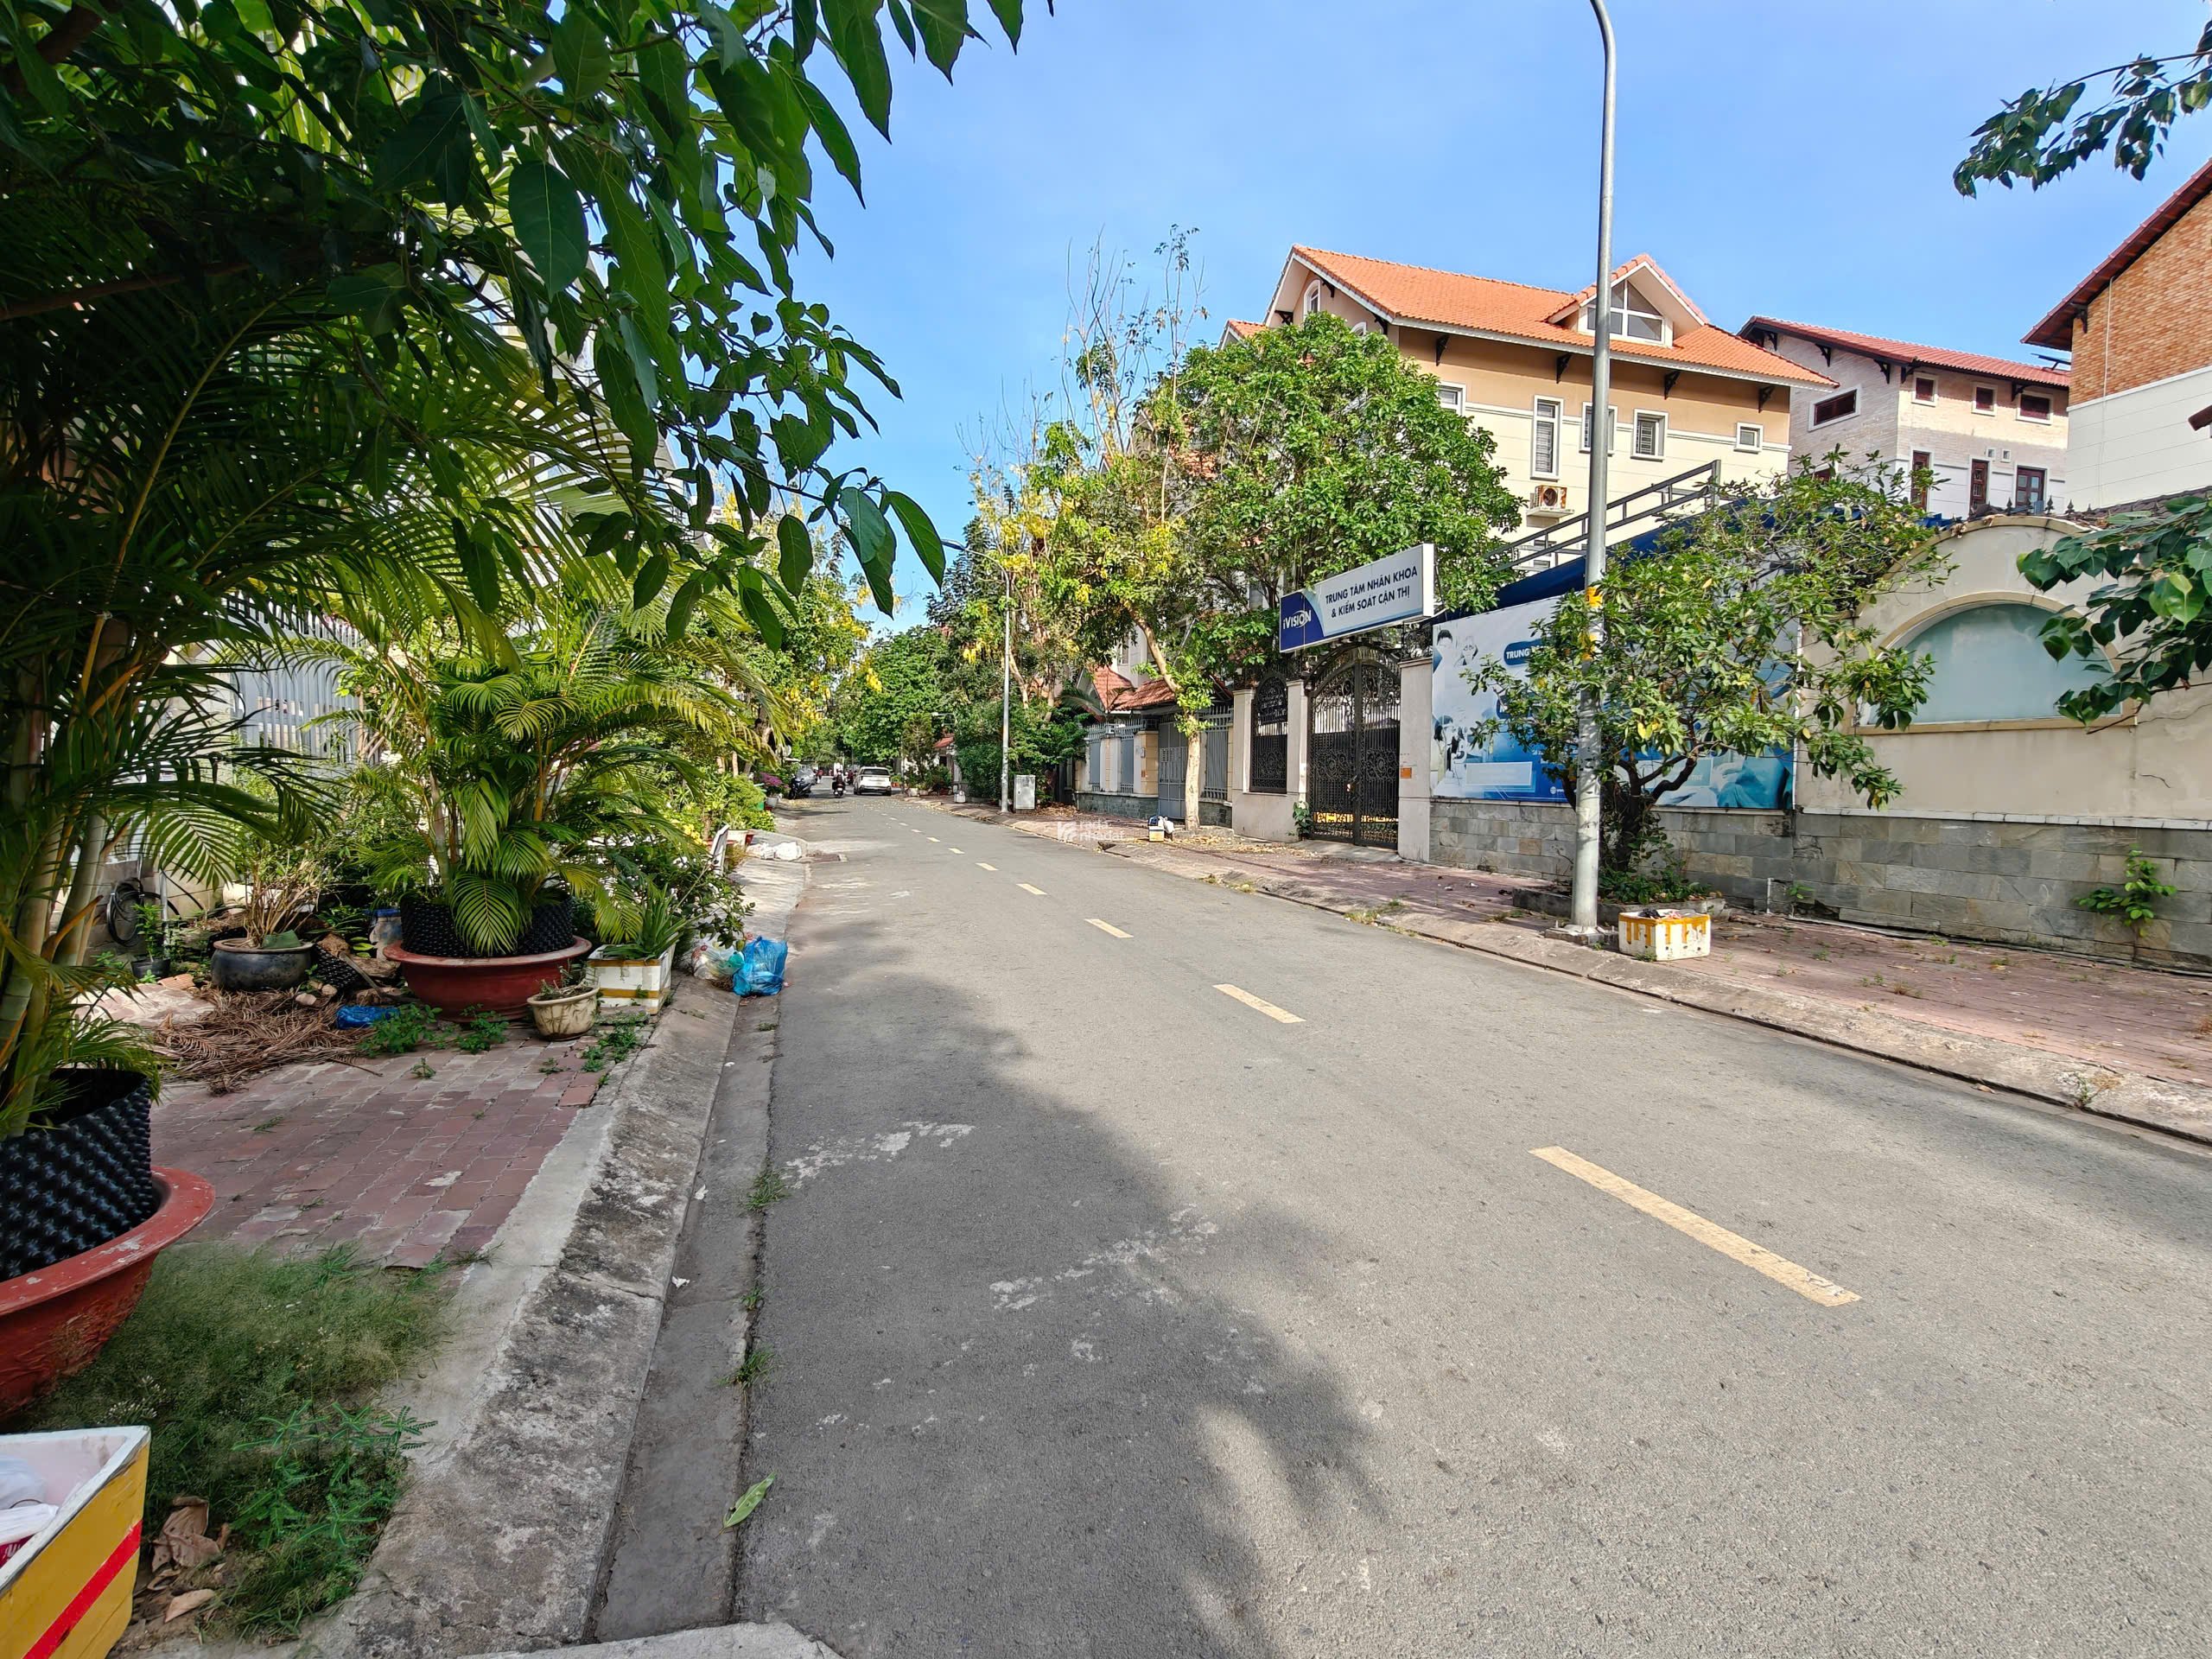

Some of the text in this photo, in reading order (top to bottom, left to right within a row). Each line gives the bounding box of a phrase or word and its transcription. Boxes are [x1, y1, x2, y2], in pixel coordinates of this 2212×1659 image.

[1325, 589, 1348, 604] TRUNG
[1351, 582, 1365, 597] TÂM
[1393, 566, 1418, 583] KHOA
[1331, 585, 1410, 618] & KIỂM SOÁT CẬN THỊ
[1506, 648, 1530, 659] TRUNG
